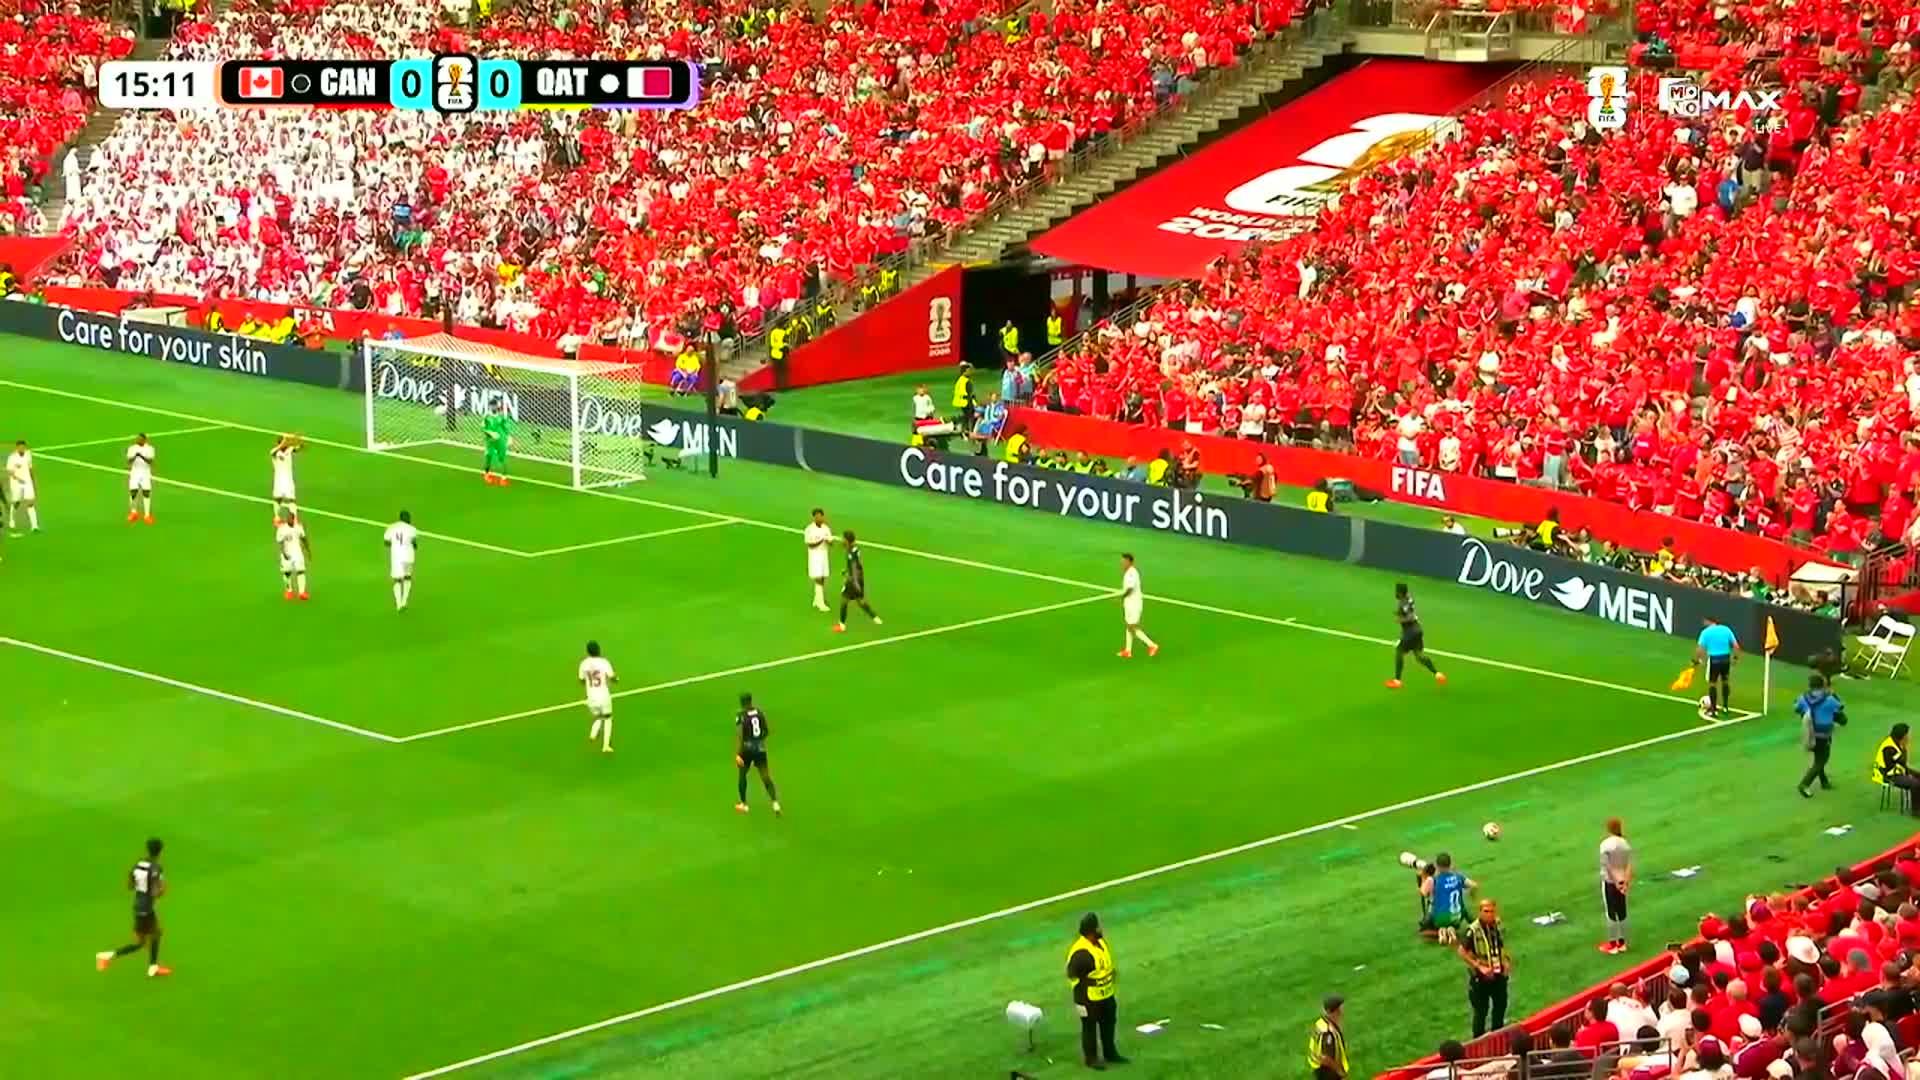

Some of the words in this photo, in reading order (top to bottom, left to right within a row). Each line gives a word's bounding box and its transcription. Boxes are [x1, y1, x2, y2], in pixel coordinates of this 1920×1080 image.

[1189, 207, 1277, 227] WORLD
[58, 310, 112, 348] Care
[118, 317, 153, 354] for
[159, 335, 212, 364] your
[219, 336, 267, 375] skin
[378, 361, 434, 404] Dove
[579, 393, 642, 439] Dove
[900, 447, 983, 497] Care
[992, 460, 1047, 507] for
[1056, 482, 1141, 523] your
[1151, 488, 1229, 539] skin
[1391, 465, 1446, 501] FIFA
[1457, 537, 1545, 600] Dove
[1599, 581, 1674, 635] MEN
[585, 670, 602, 687] 15
[750, 716, 761, 737] 8
